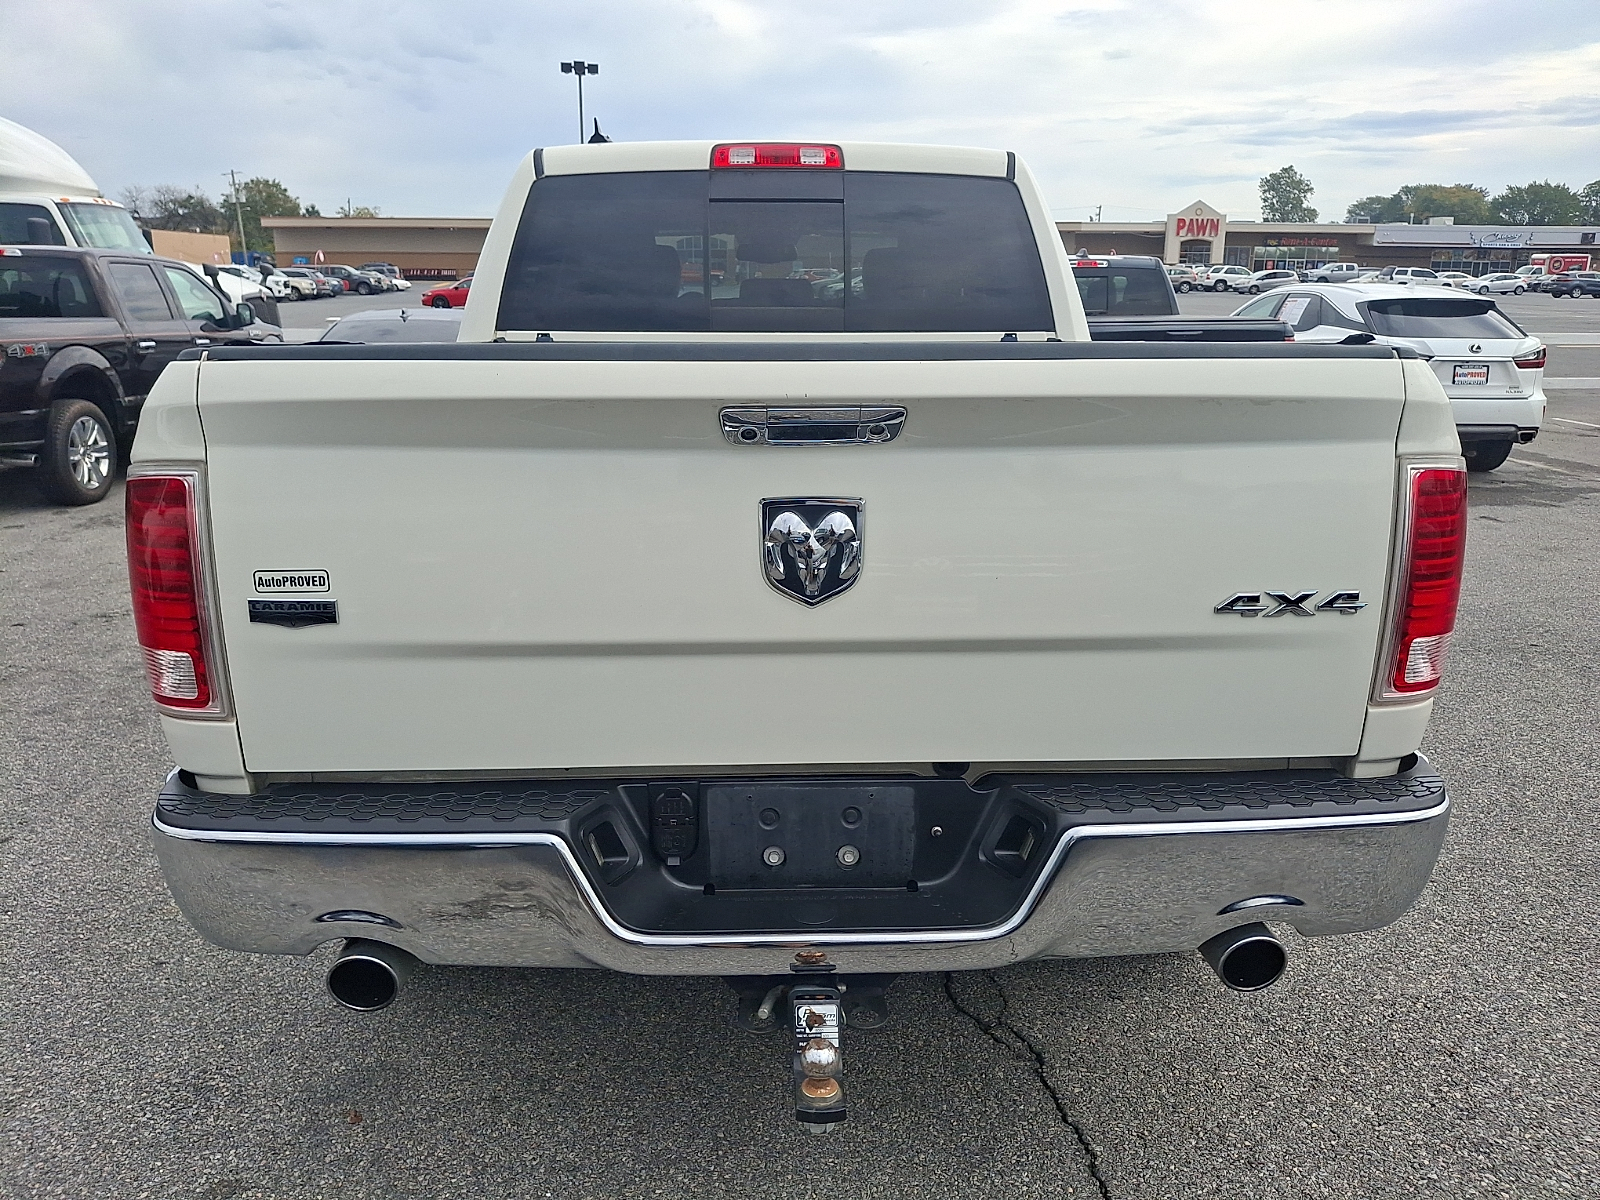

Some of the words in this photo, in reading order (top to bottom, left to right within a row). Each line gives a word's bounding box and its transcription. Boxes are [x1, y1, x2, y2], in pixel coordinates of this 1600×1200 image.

[1175, 217, 1220, 237] PAWN
[257, 575, 326, 588] AutoPROVED
[249, 601, 335, 612] LARAMIE
